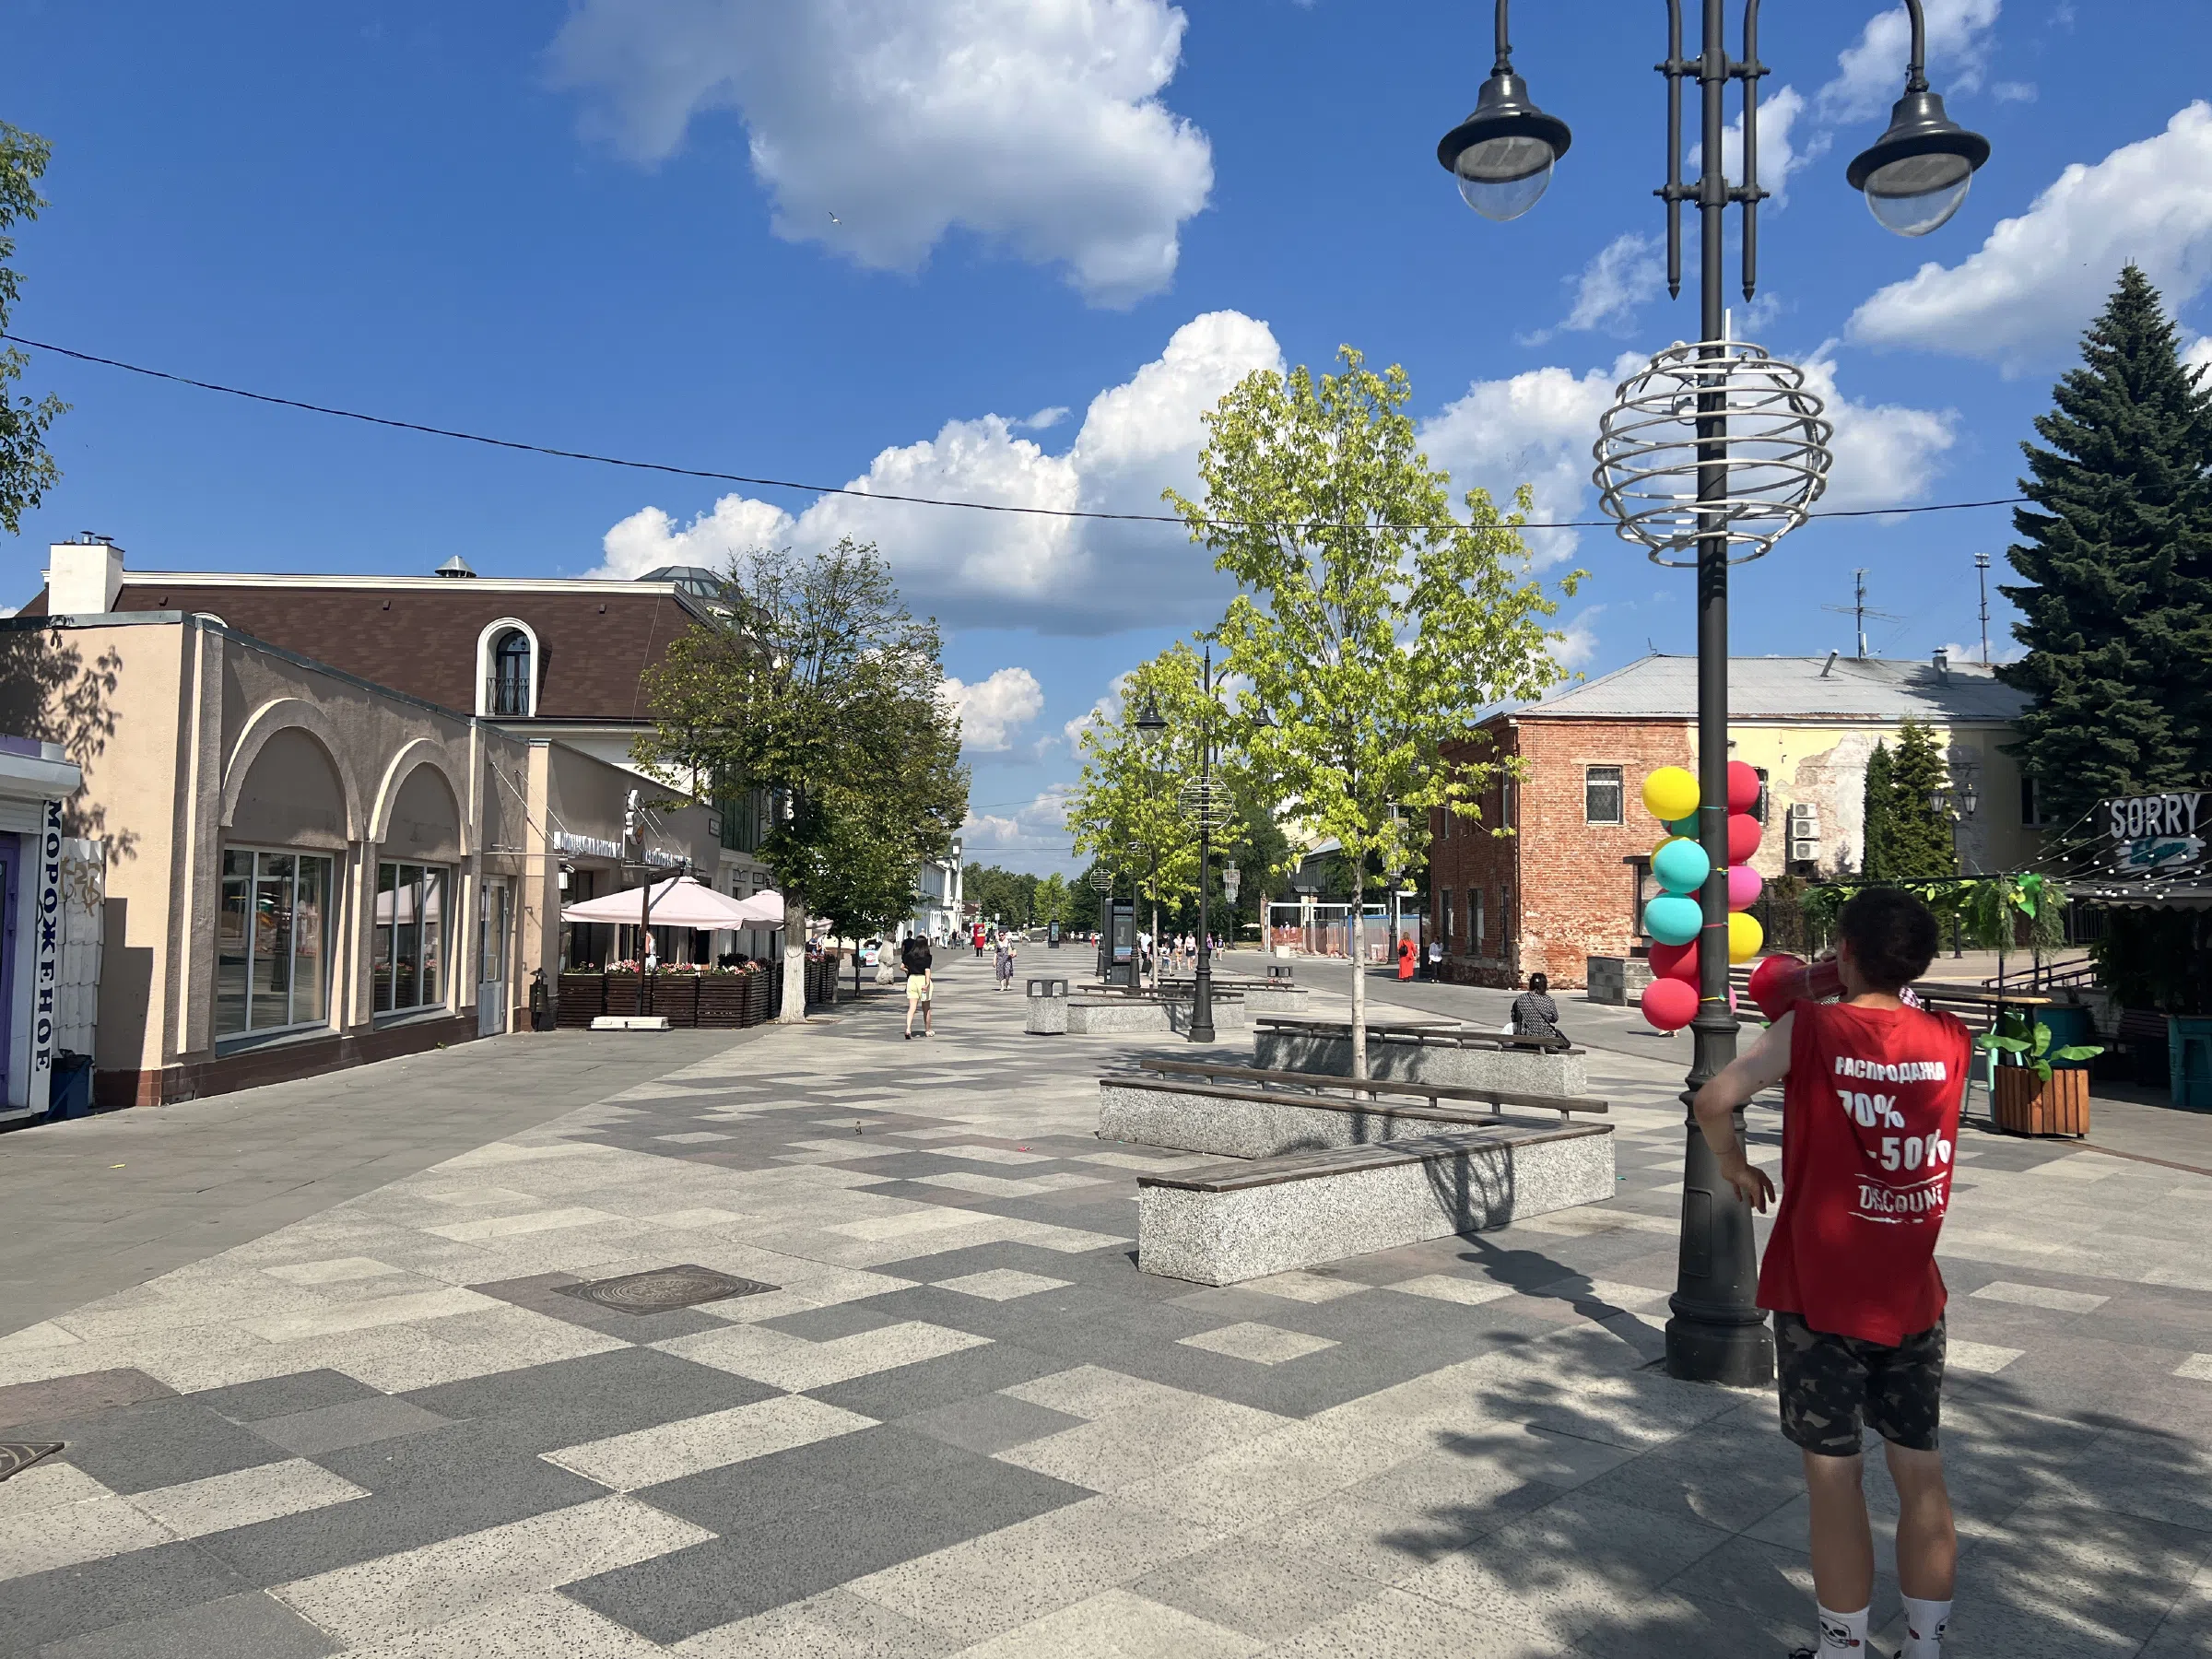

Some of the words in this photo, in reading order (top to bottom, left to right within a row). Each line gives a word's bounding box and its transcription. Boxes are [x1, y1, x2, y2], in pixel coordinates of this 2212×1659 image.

[2111, 794, 2201, 839] SORRY
[36, 801, 62, 1072] МОРОЖЕНОЕ
[1835, 1056, 1947, 1083] РАСПРОДАЖА
[1836, 1089, 1905, 1128] 70%
[1866, 1129, 1952, 1171] -50%
